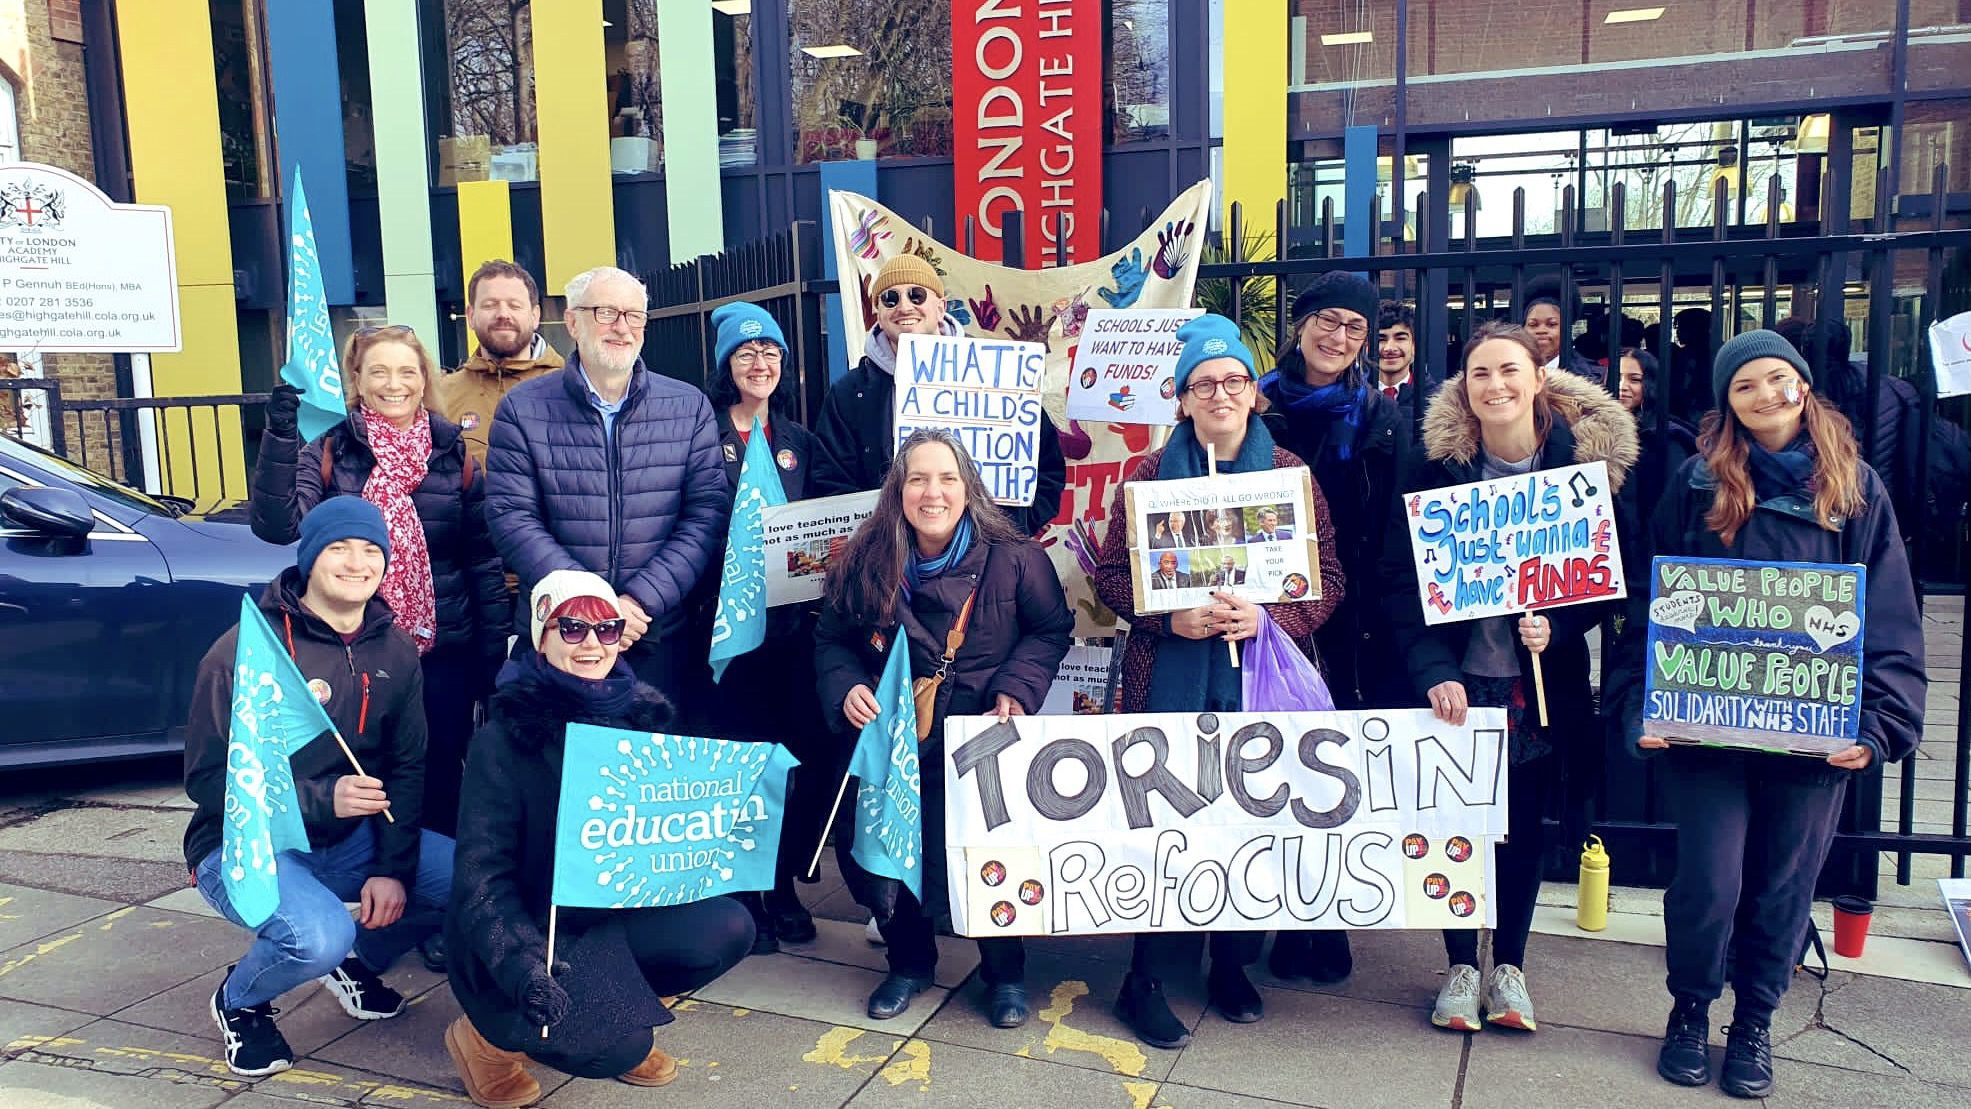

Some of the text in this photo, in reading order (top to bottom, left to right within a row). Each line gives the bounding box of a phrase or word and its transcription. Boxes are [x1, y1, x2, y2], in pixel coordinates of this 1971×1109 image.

[975, 0, 1025, 265] ONDON
[0, 236, 13, 246] TY
[26, 237, 76, 247] LONDON
[8, 246, 57, 255] ACADEMY
[51, 256, 72, 265] HILL
[3, 279, 11, 288] P
[15, 279, 62, 290] Gennuh
[120, 283, 142, 291] MBA
[6, 297, 94, 308] 0207 281 3536
[0, 309, 156, 323] es@highgatehill.cola.org.uk
[0, 327, 121, 339] ghgatehill.cola.org.uk
[1094, 319, 1155, 333] SCHOOLS
[1090, 340, 1128, 355] WANT
[1128, 341, 1145, 355] TO
[1145, 341, 1185, 356] HAVE
[910, 340, 1015, 389] WHAT
[1103, 363, 1159, 380] FUNDS!
[901, 386, 1040, 426] A CHILD'S
[1159, 499, 1191, 508] WHERE
[1194, 497, 1209, 506] DID
[1222, 495, 1236, 503] ALL
[1238, 493, 1252, 502] GO
[1254, 490, 1295, 501] WRONG?
[1418, 476, 1562, 542] Schools
[768, 524, 794, 534] love
[797, 515, 850, 529] teaching
[853, 510, 873, 520] but
[785, 534, 799, 542] as
[802, 527, 836, 539] much
[839, 525, 854, 534] as
[1434, 529, 1507, 584] Just
[1515, 517, 1590, 558] wanna
[1265, 558, 1284, 566] YOUR
[1454, 567, 1504, 611] have
[1660, 564, 1857, 602] VALUE PEOPLE
[1653, 594, 1702, 618] STUDENTS
[1707, 596, 1793, 629] WHO
[1809, 616, 1850, 638] NHS
[1061, 662, 1081, 671] love
[1654, 640, 1859, 706] VALUE PEOPLE
[1087, 676, 1109, 684] muc
[1650, 690, 1850, 738] SOLIDARITY WITH NHS STAFF
[639, 769, 743, 803] national
[1405, 837, 1423, 846] PAY
[1405, 844, 1419, 856] UP
[1446, 843, 1461, 857] UP
[651, 845, 721, 874] union
[985, 871, 999, 885] UP
[1426, 877, 1444, 885] PAY
[1023, 881, 1041, 892] PAY
[1426, 884, 1440, 896] UP
[1021, 887, 1034, 902] UP
[1452, 902, 1467, 916] UP
[995, 911, 1009, 926] UP
